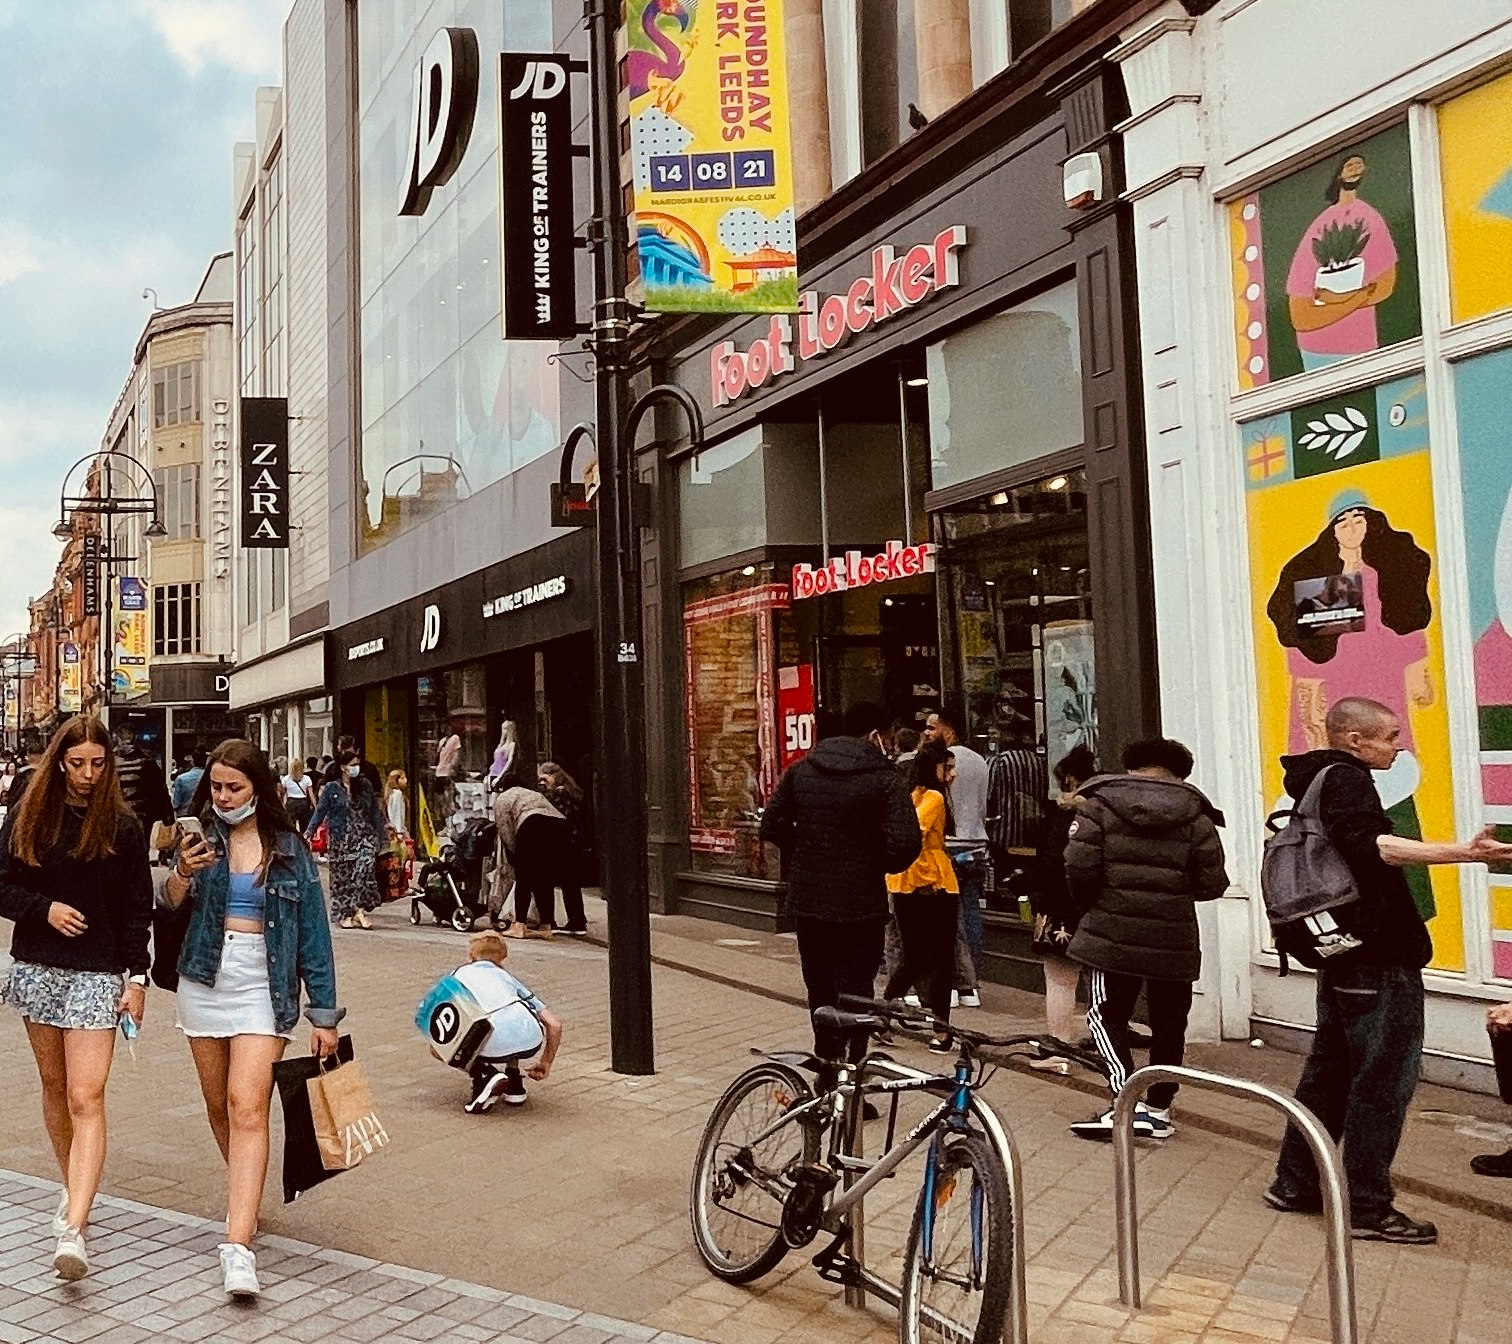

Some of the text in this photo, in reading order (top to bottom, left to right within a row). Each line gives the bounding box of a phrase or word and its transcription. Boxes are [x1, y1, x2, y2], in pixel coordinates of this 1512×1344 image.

[510, 62, 566, 100] JD
[719, 55, 745, 143] LEEDS
[657, 159, 766, 182] 14 08 21
[530, 111, 551, 288] KING OF TRAINERS
[798, 224, 967, 361] Locker
[248, 443, 281, 539] ZARA
[844, 540, 936, 589] Locker
[494, 594, 514, 615] KING
[522, 575, 566, 606] TRAINERS
[420, 604, 441, 654] JD
[619, 642, 636, 654] 34
[435, 1006, 455, 1043] JD
